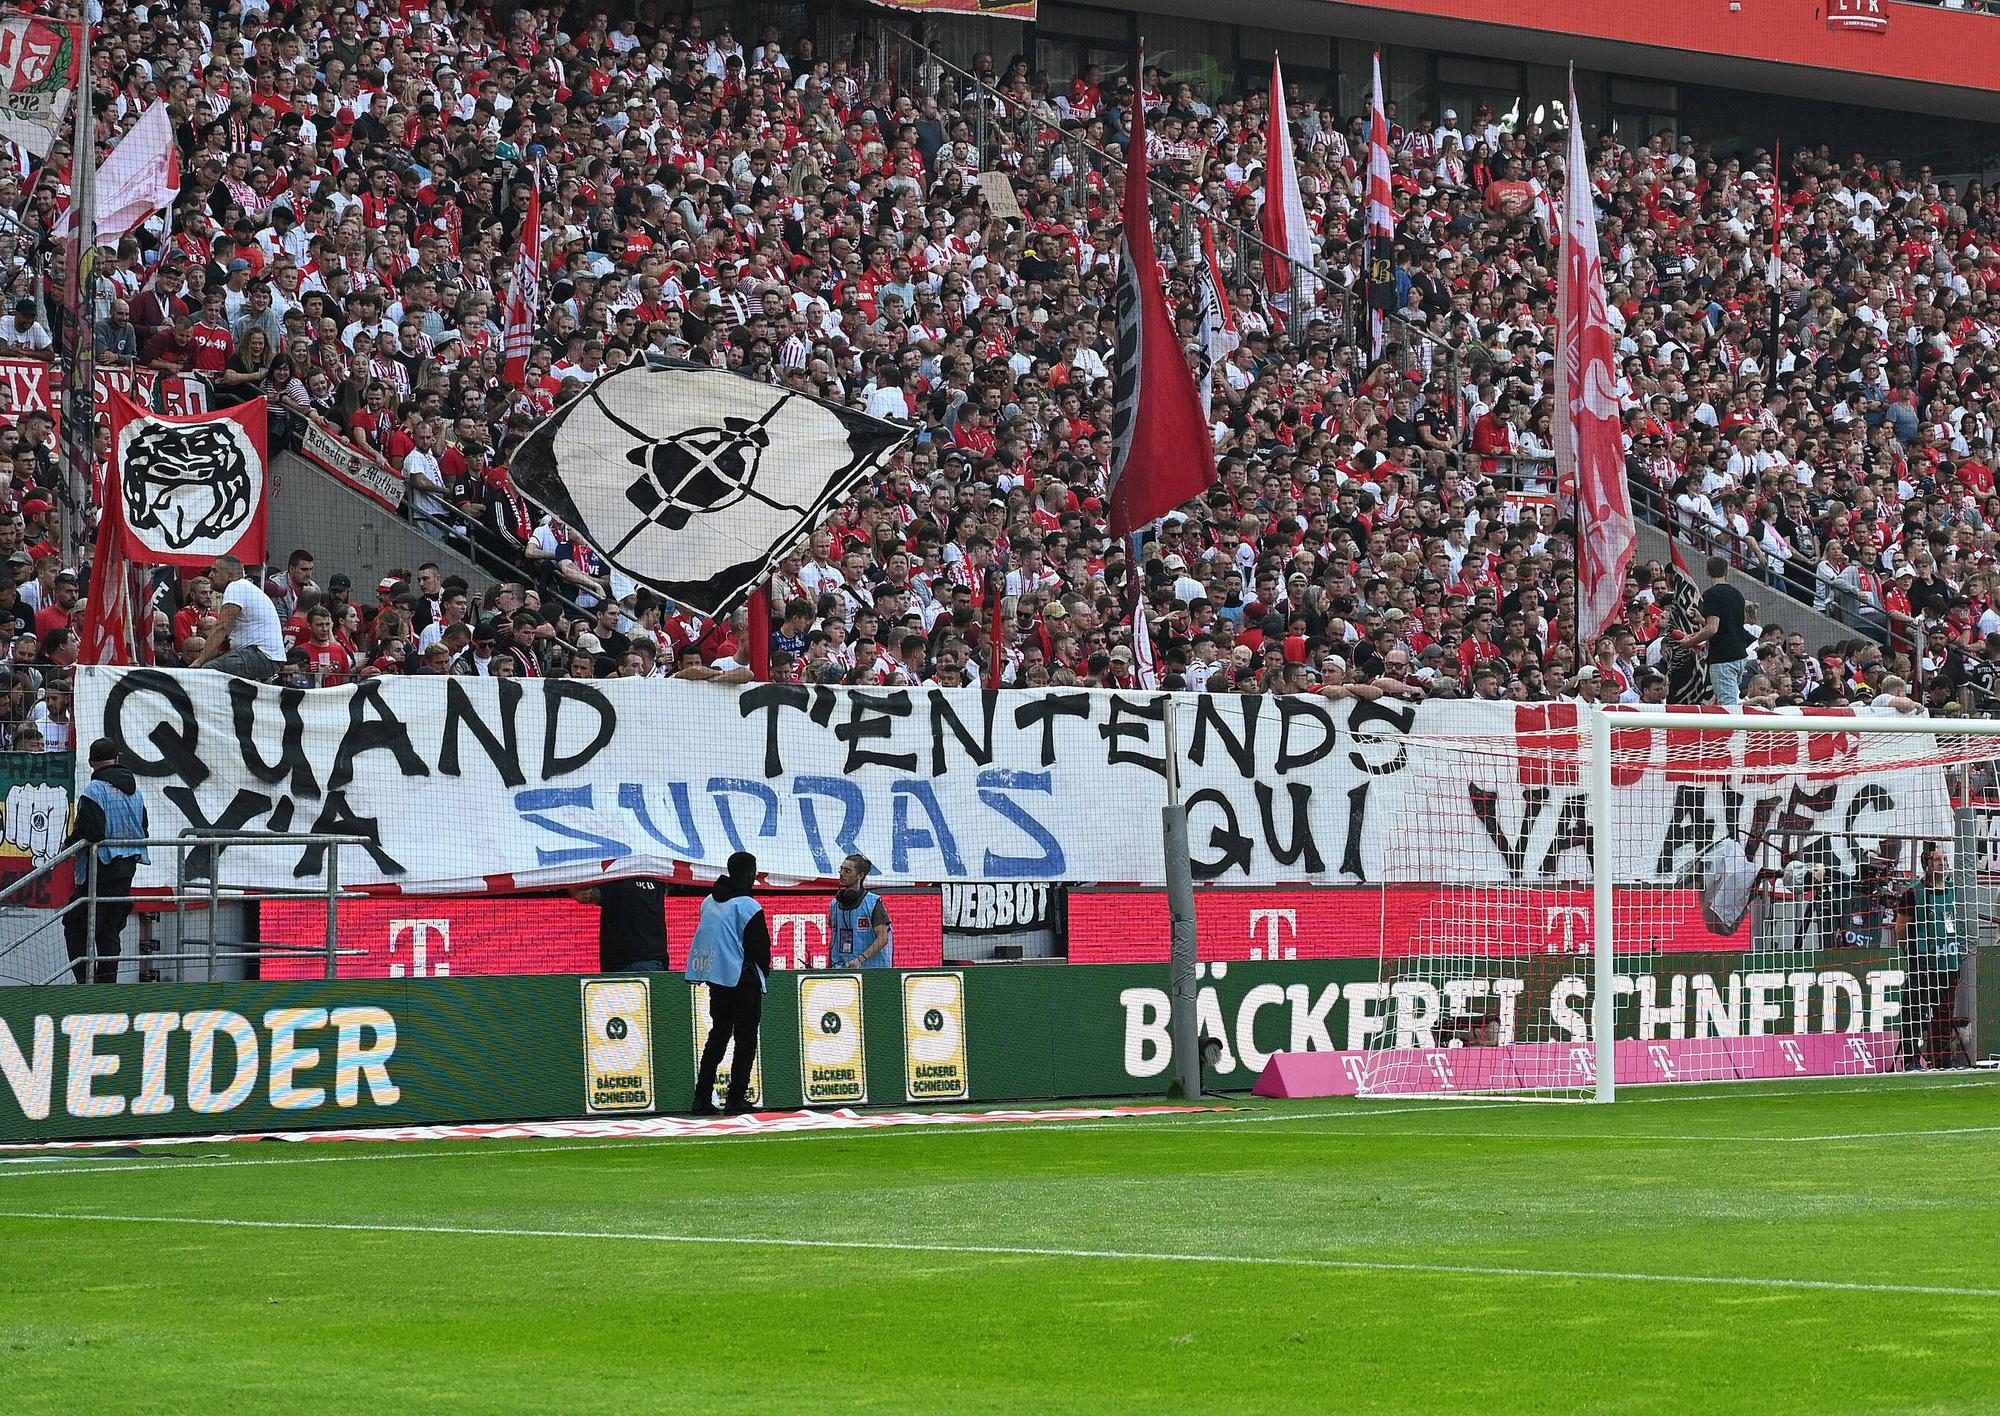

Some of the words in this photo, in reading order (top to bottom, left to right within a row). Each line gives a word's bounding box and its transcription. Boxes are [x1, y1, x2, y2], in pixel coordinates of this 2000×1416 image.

[104, 669, 617, 799] QUAND
[739, 683, 1416, 788] T'ENTENDS
[514, 768, 1067, 878] SUPRAS
[1184, 781, 1371, 881] QUI
[1467, 781, 1596, 879] VA
[941, 882, 1050, 929] VERBOT
[594, 1090, 646, 1104] SCHNEIDER
[810, 1082, 861, 1096] SCHNEIDER
[913, 1079, 961, 1093] SCHNEIDER
